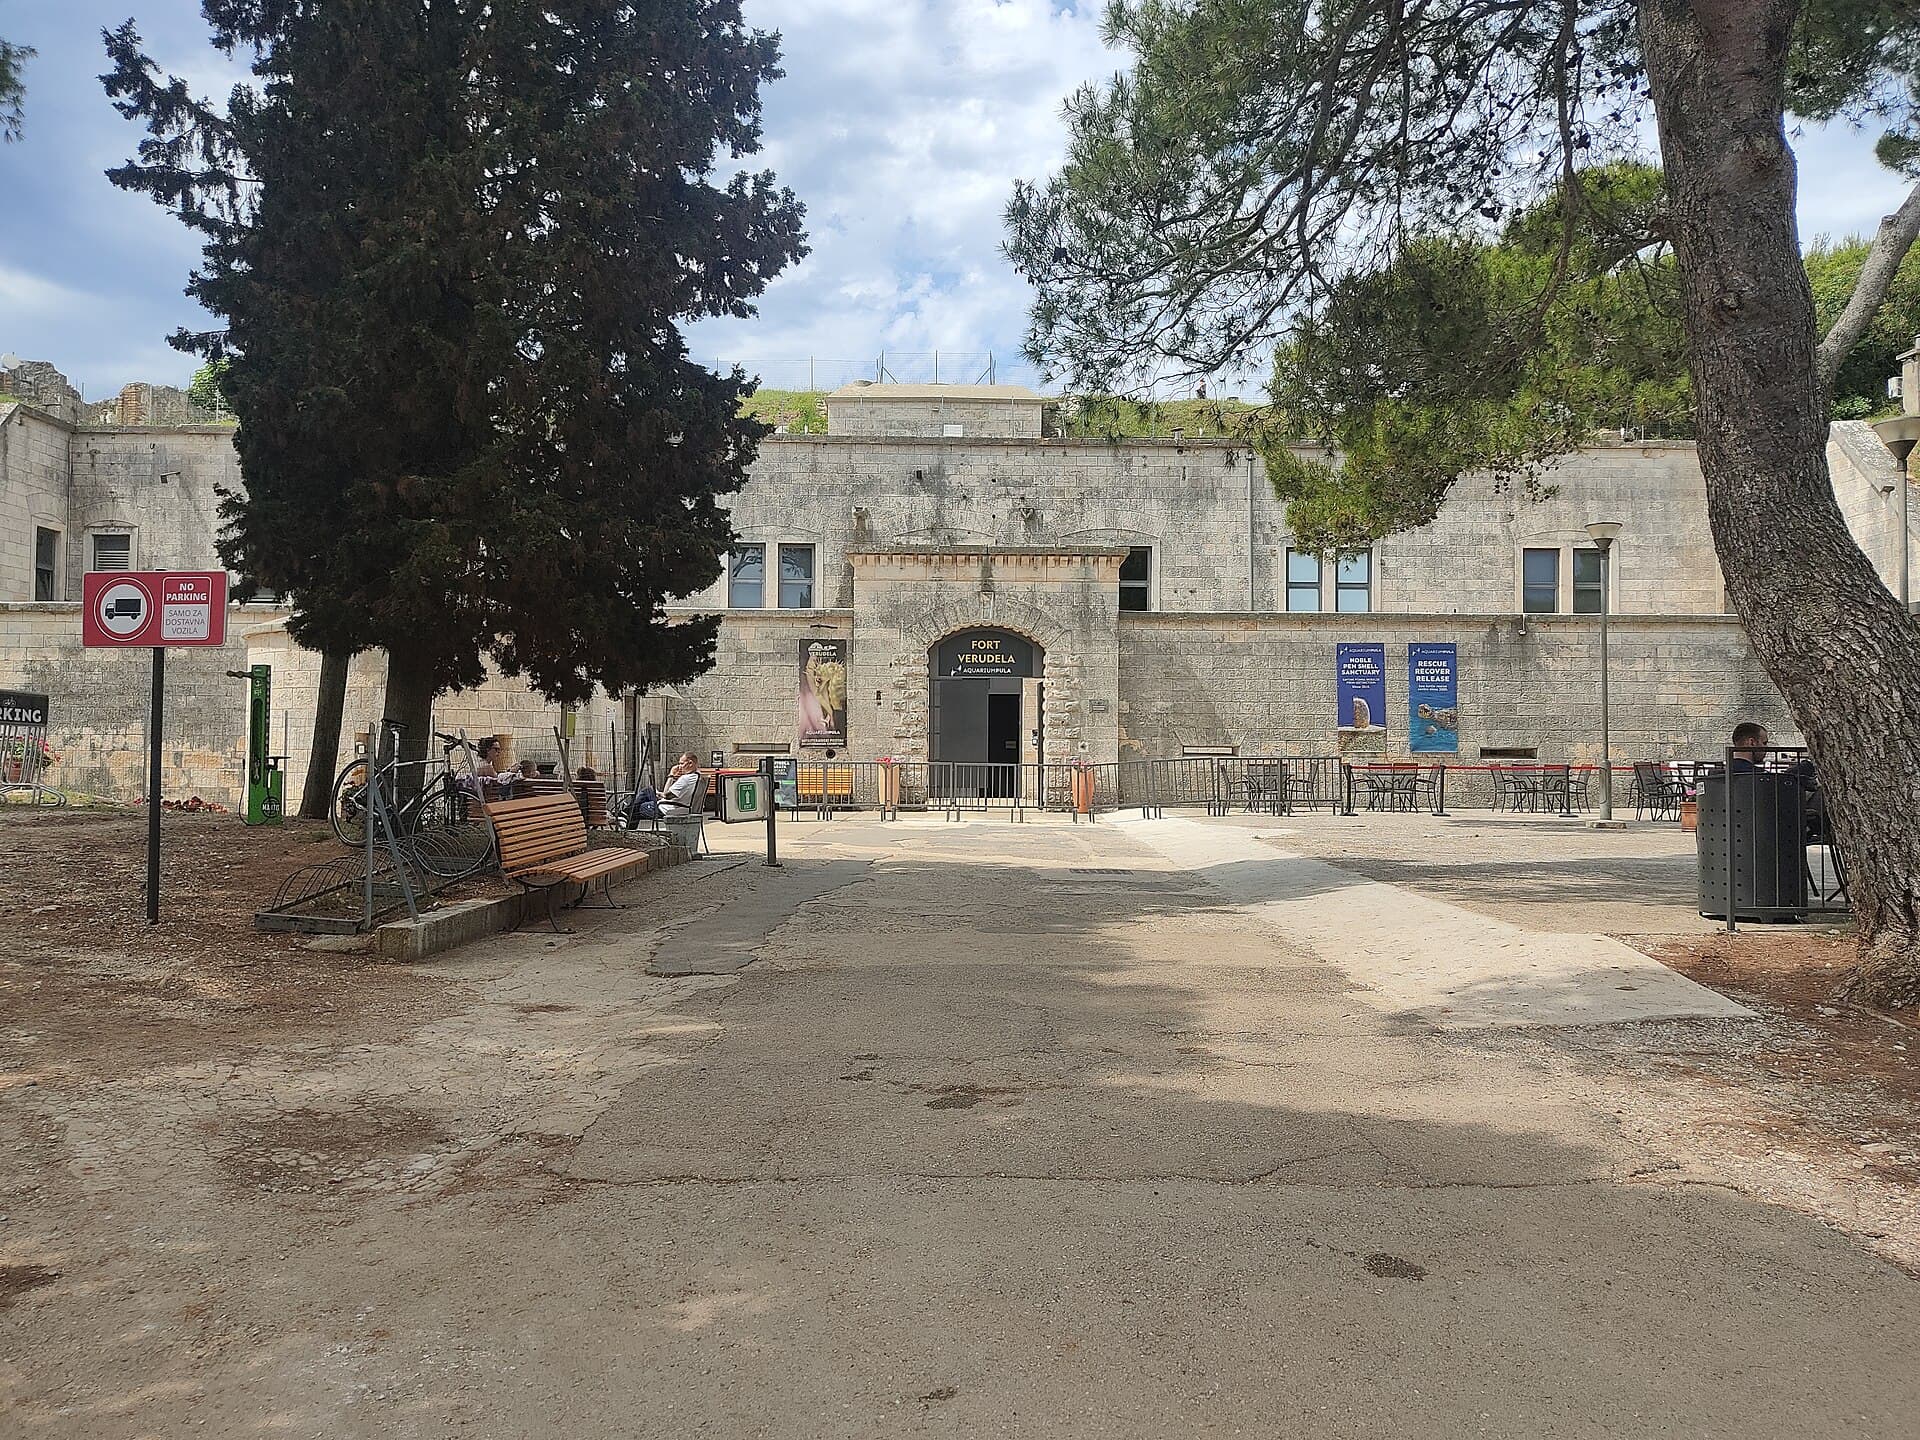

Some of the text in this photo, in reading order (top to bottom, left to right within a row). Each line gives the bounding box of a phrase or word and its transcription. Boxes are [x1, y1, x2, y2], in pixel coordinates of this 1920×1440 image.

[179, 583, 194, 591] NO
[166, 592, 207, 601] PARKING
[168, 609, 203, 617] SAMO ZA
[165, 618, 205, 626] DOSTAVNA
[171, 627, 199, 635] VOZILA
[971, 640, 1001, 650] FORT
[957, 654, 1016, 664] VERUDELA
[0, 707, 42, 723] KING
